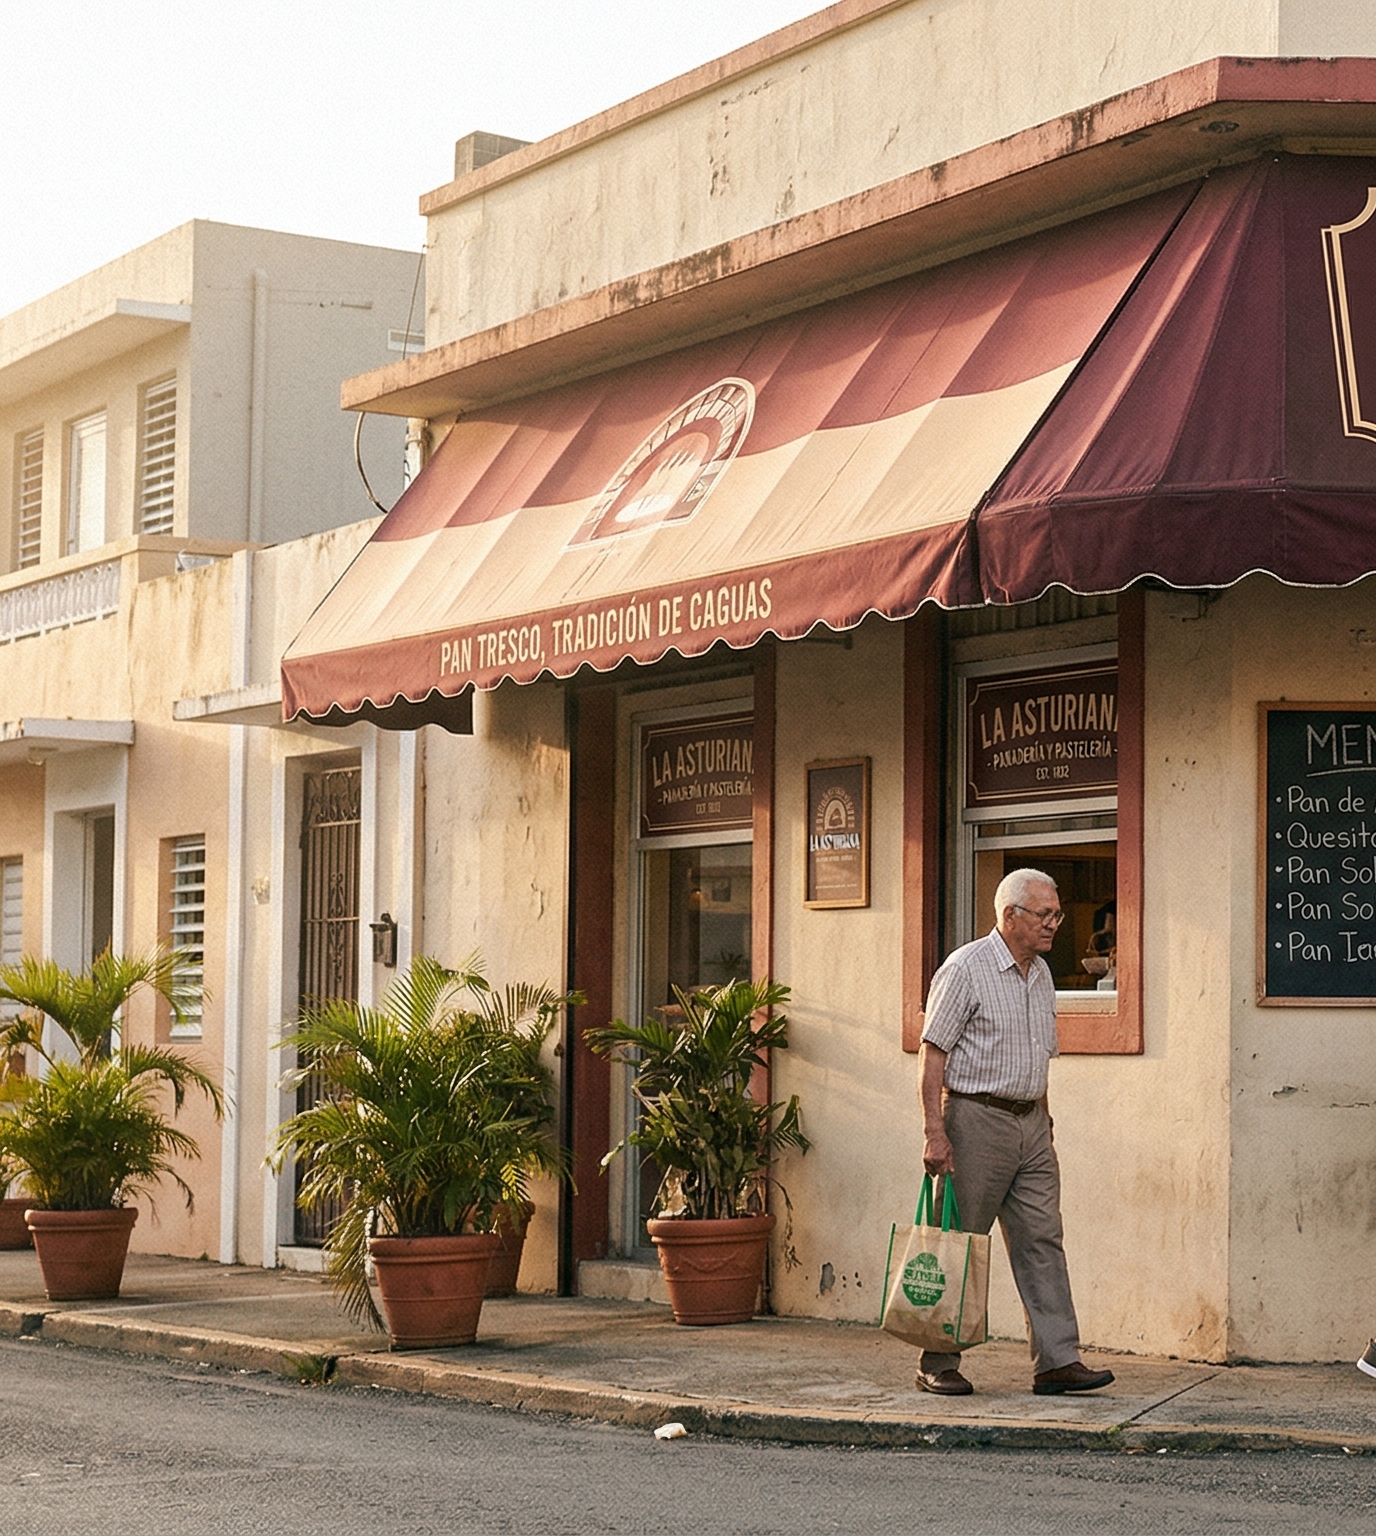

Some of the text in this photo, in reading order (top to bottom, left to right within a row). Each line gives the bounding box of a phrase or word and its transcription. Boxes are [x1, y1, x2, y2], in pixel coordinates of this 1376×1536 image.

[440, 577, 773, 678] PAN TRESCO, TRADICIÓN DE CAGUAS
[980, 706, 1006, 750] LA
[652, 739, 754, 788] LA ASTURIAN
[1287, 785, 1330, 813] Pan
[1338, 785, 1366, 813] de
[1287, 855, 1331, 884] Pan
[1287, 891, 1331, 920] Pan
[1288, 931, 1332, 962] Pan
